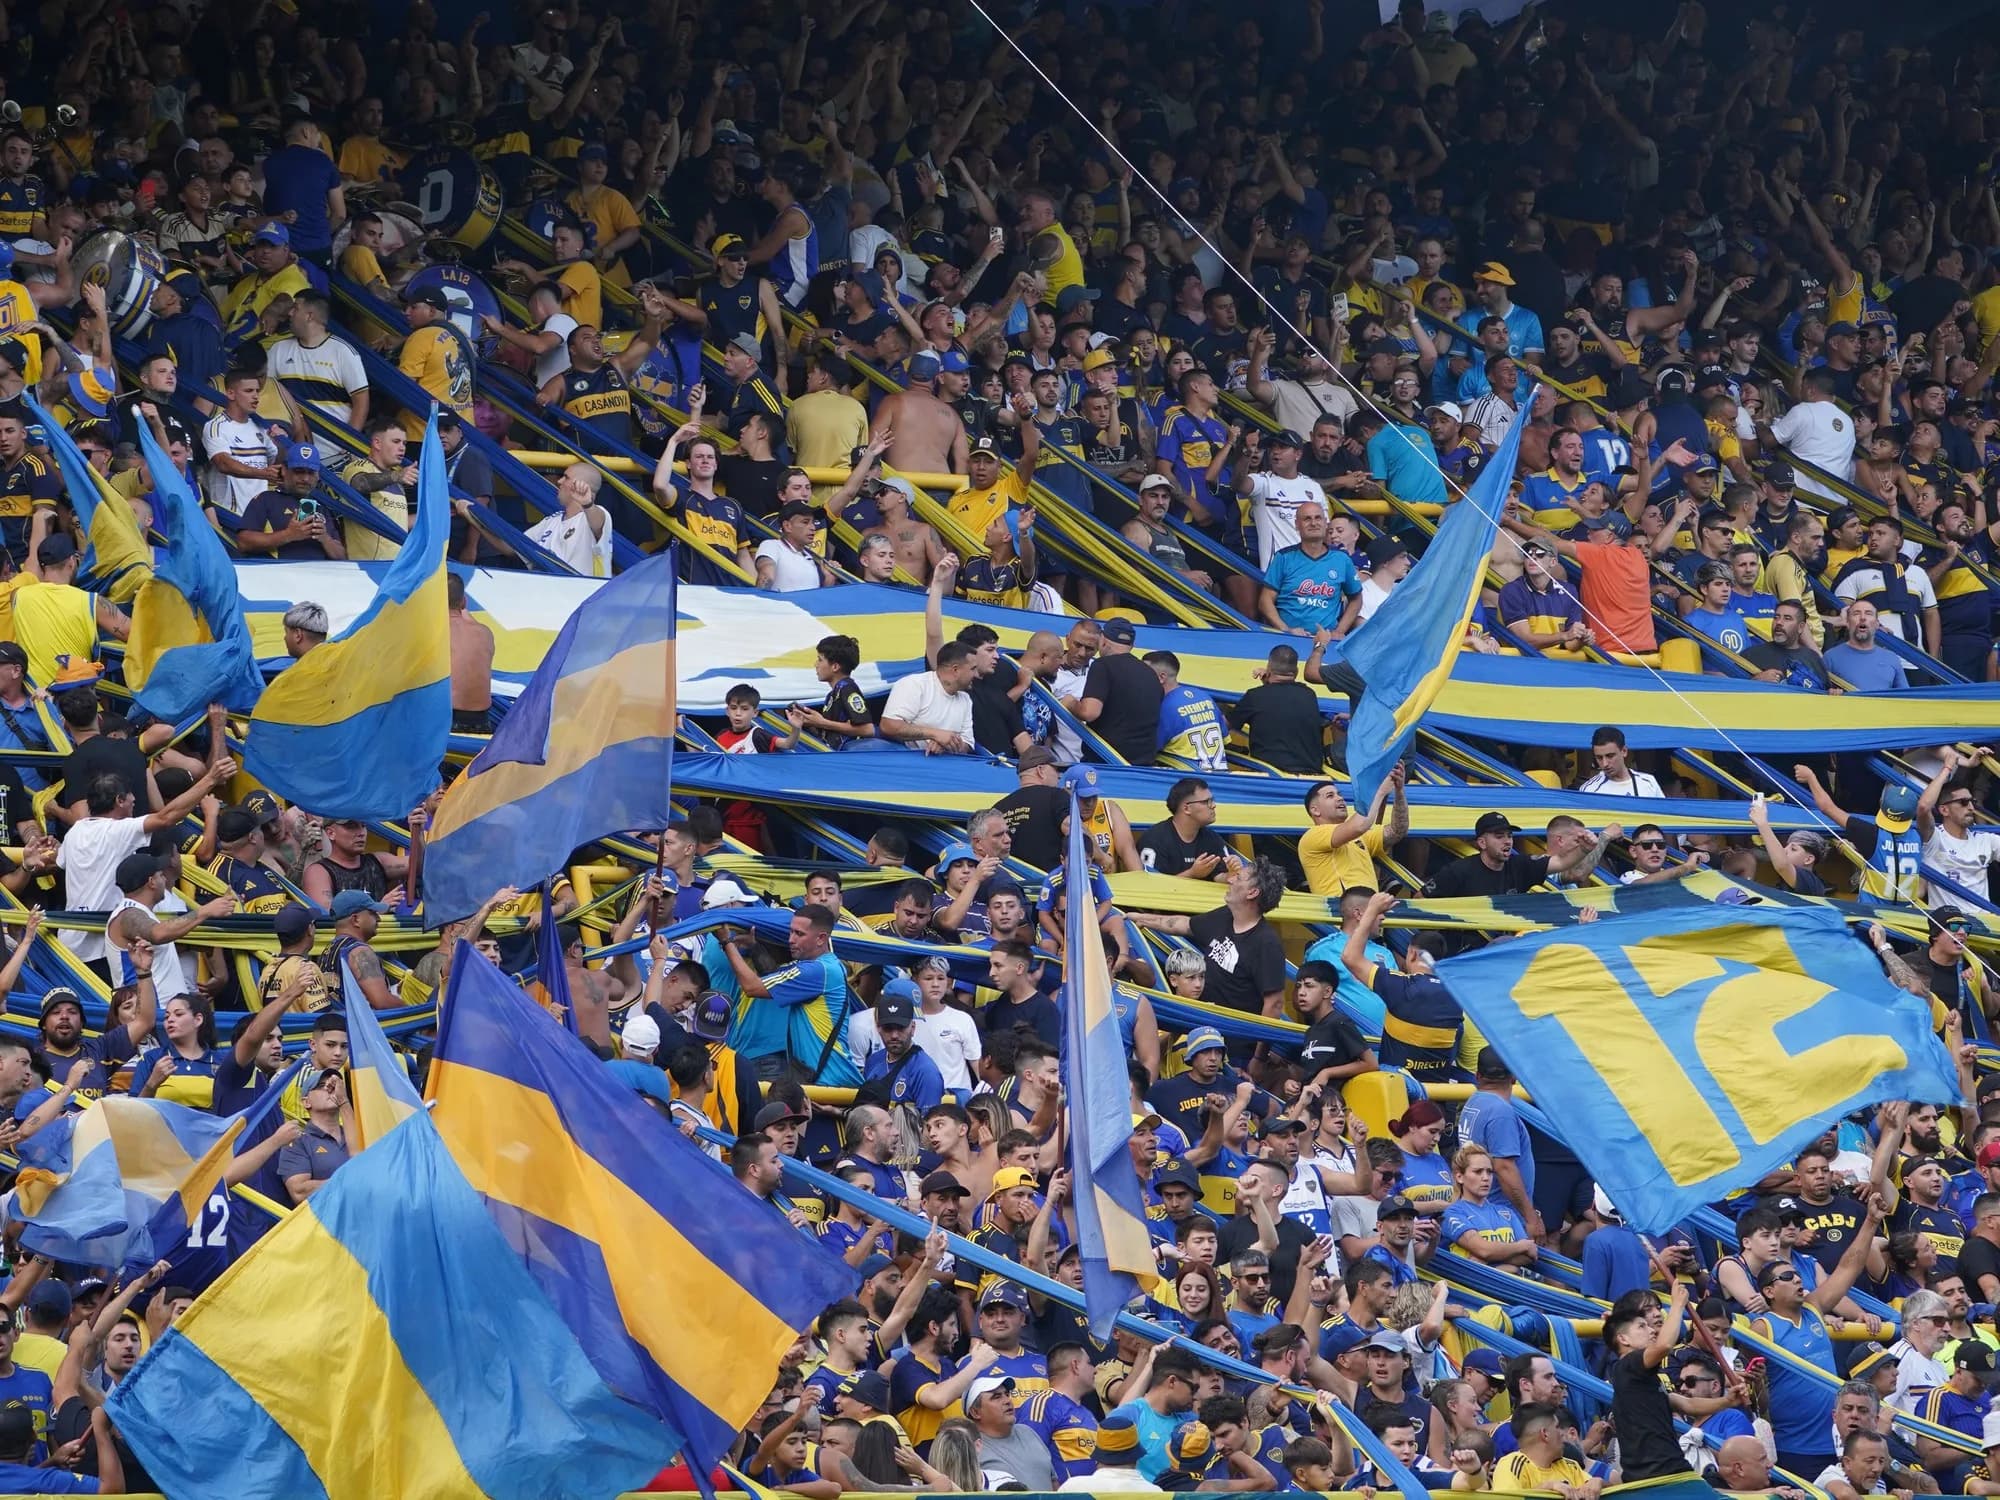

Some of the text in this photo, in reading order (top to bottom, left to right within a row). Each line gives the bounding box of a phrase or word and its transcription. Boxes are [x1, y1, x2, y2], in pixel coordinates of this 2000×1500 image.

[1292, 578, 1335, 597] Lete
[1307, 598, 1329, 609] MSC
[1724, 634, 1739, 650] 90
[1187, 727, 1229, 771] 12
[1510, 922, 1909, 1187] 12
[1406, 1058, 1447, 1071] DIRECTV
[187, 1193, 230, 1247] 12
[1804, 1213, 1857, 1231] CABJ
